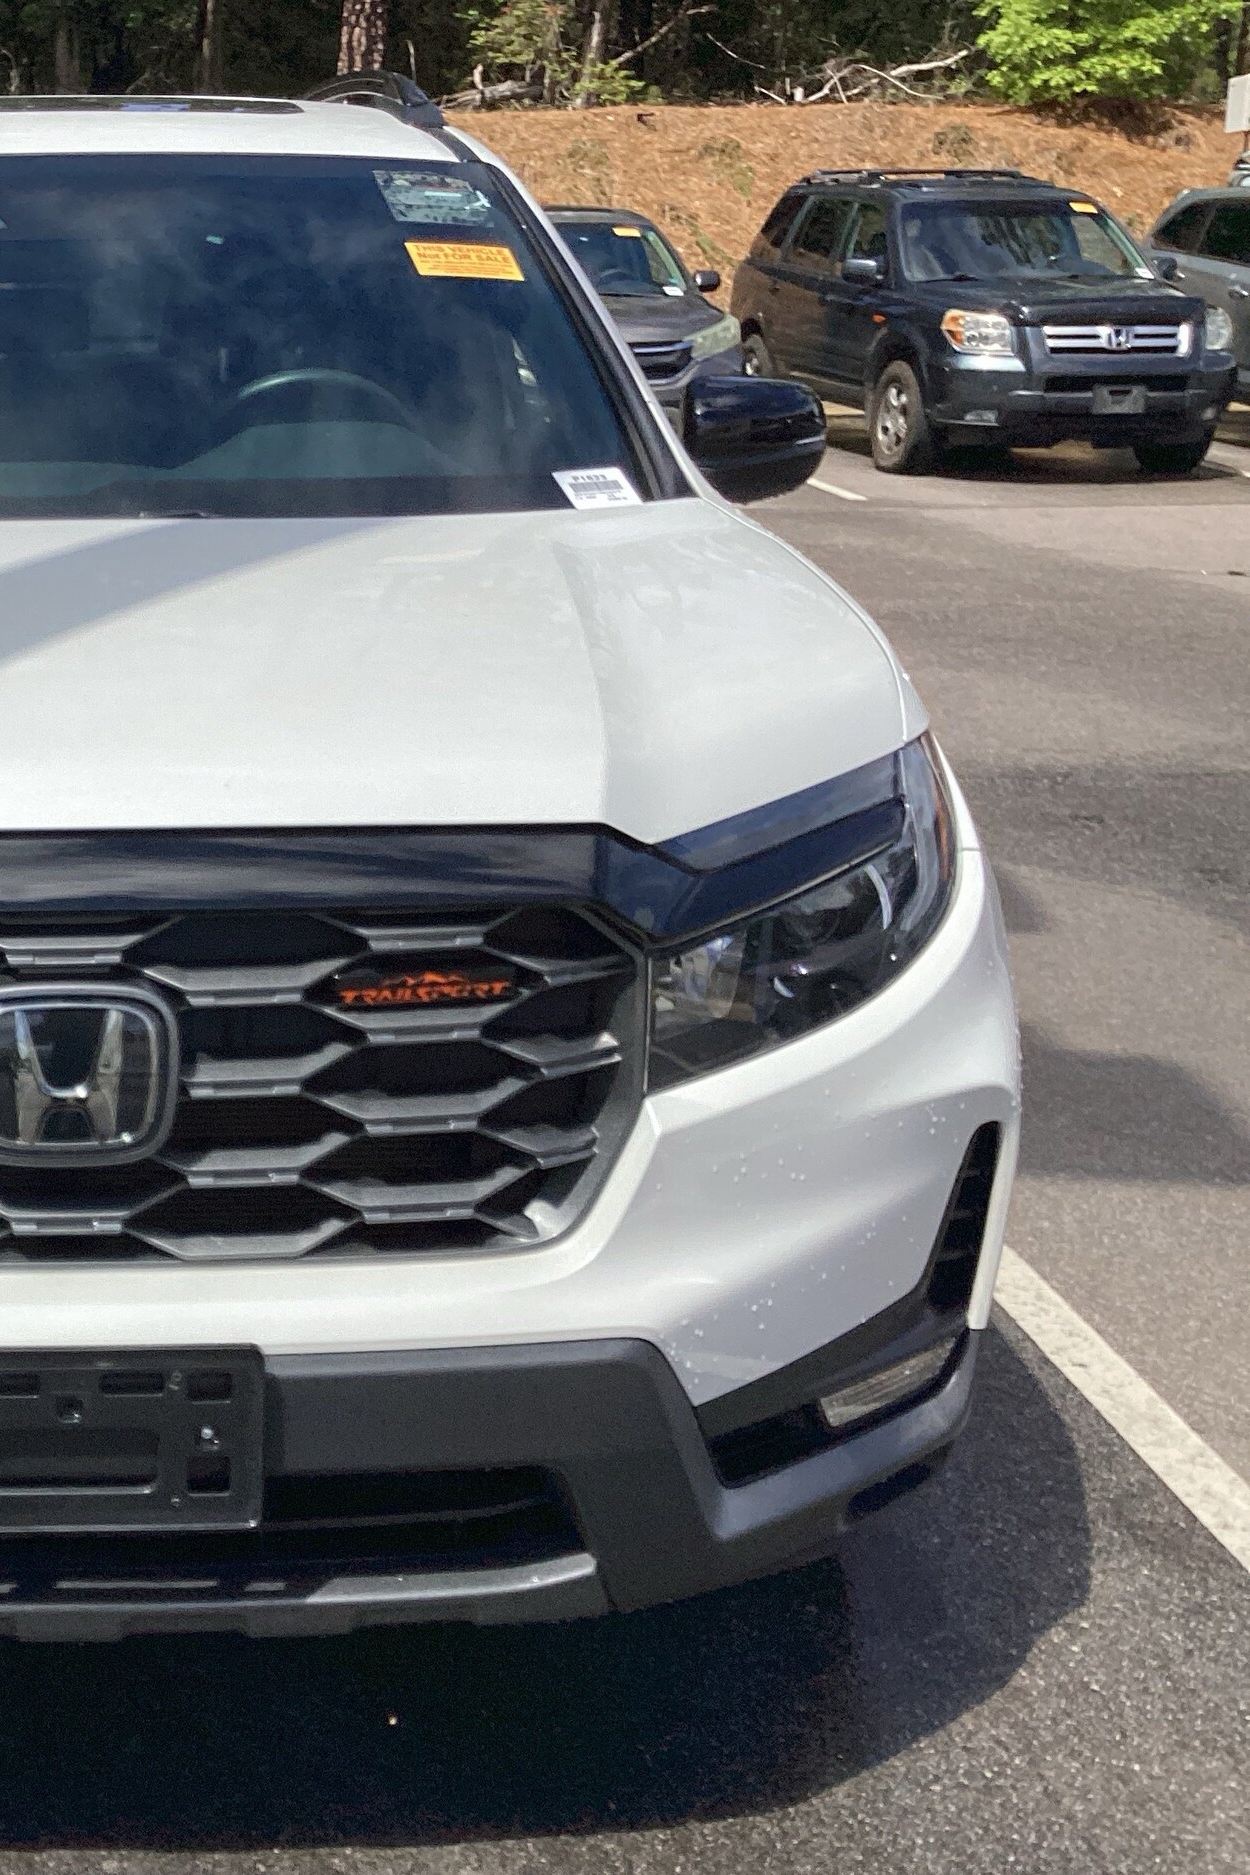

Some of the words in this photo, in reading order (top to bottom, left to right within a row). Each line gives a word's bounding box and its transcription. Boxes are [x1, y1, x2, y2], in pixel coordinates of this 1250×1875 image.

[447, 246, 506, 256] VEHICLE
[444, 253, 473, 262] FOR
[477, 254, 512, 264] SALE
